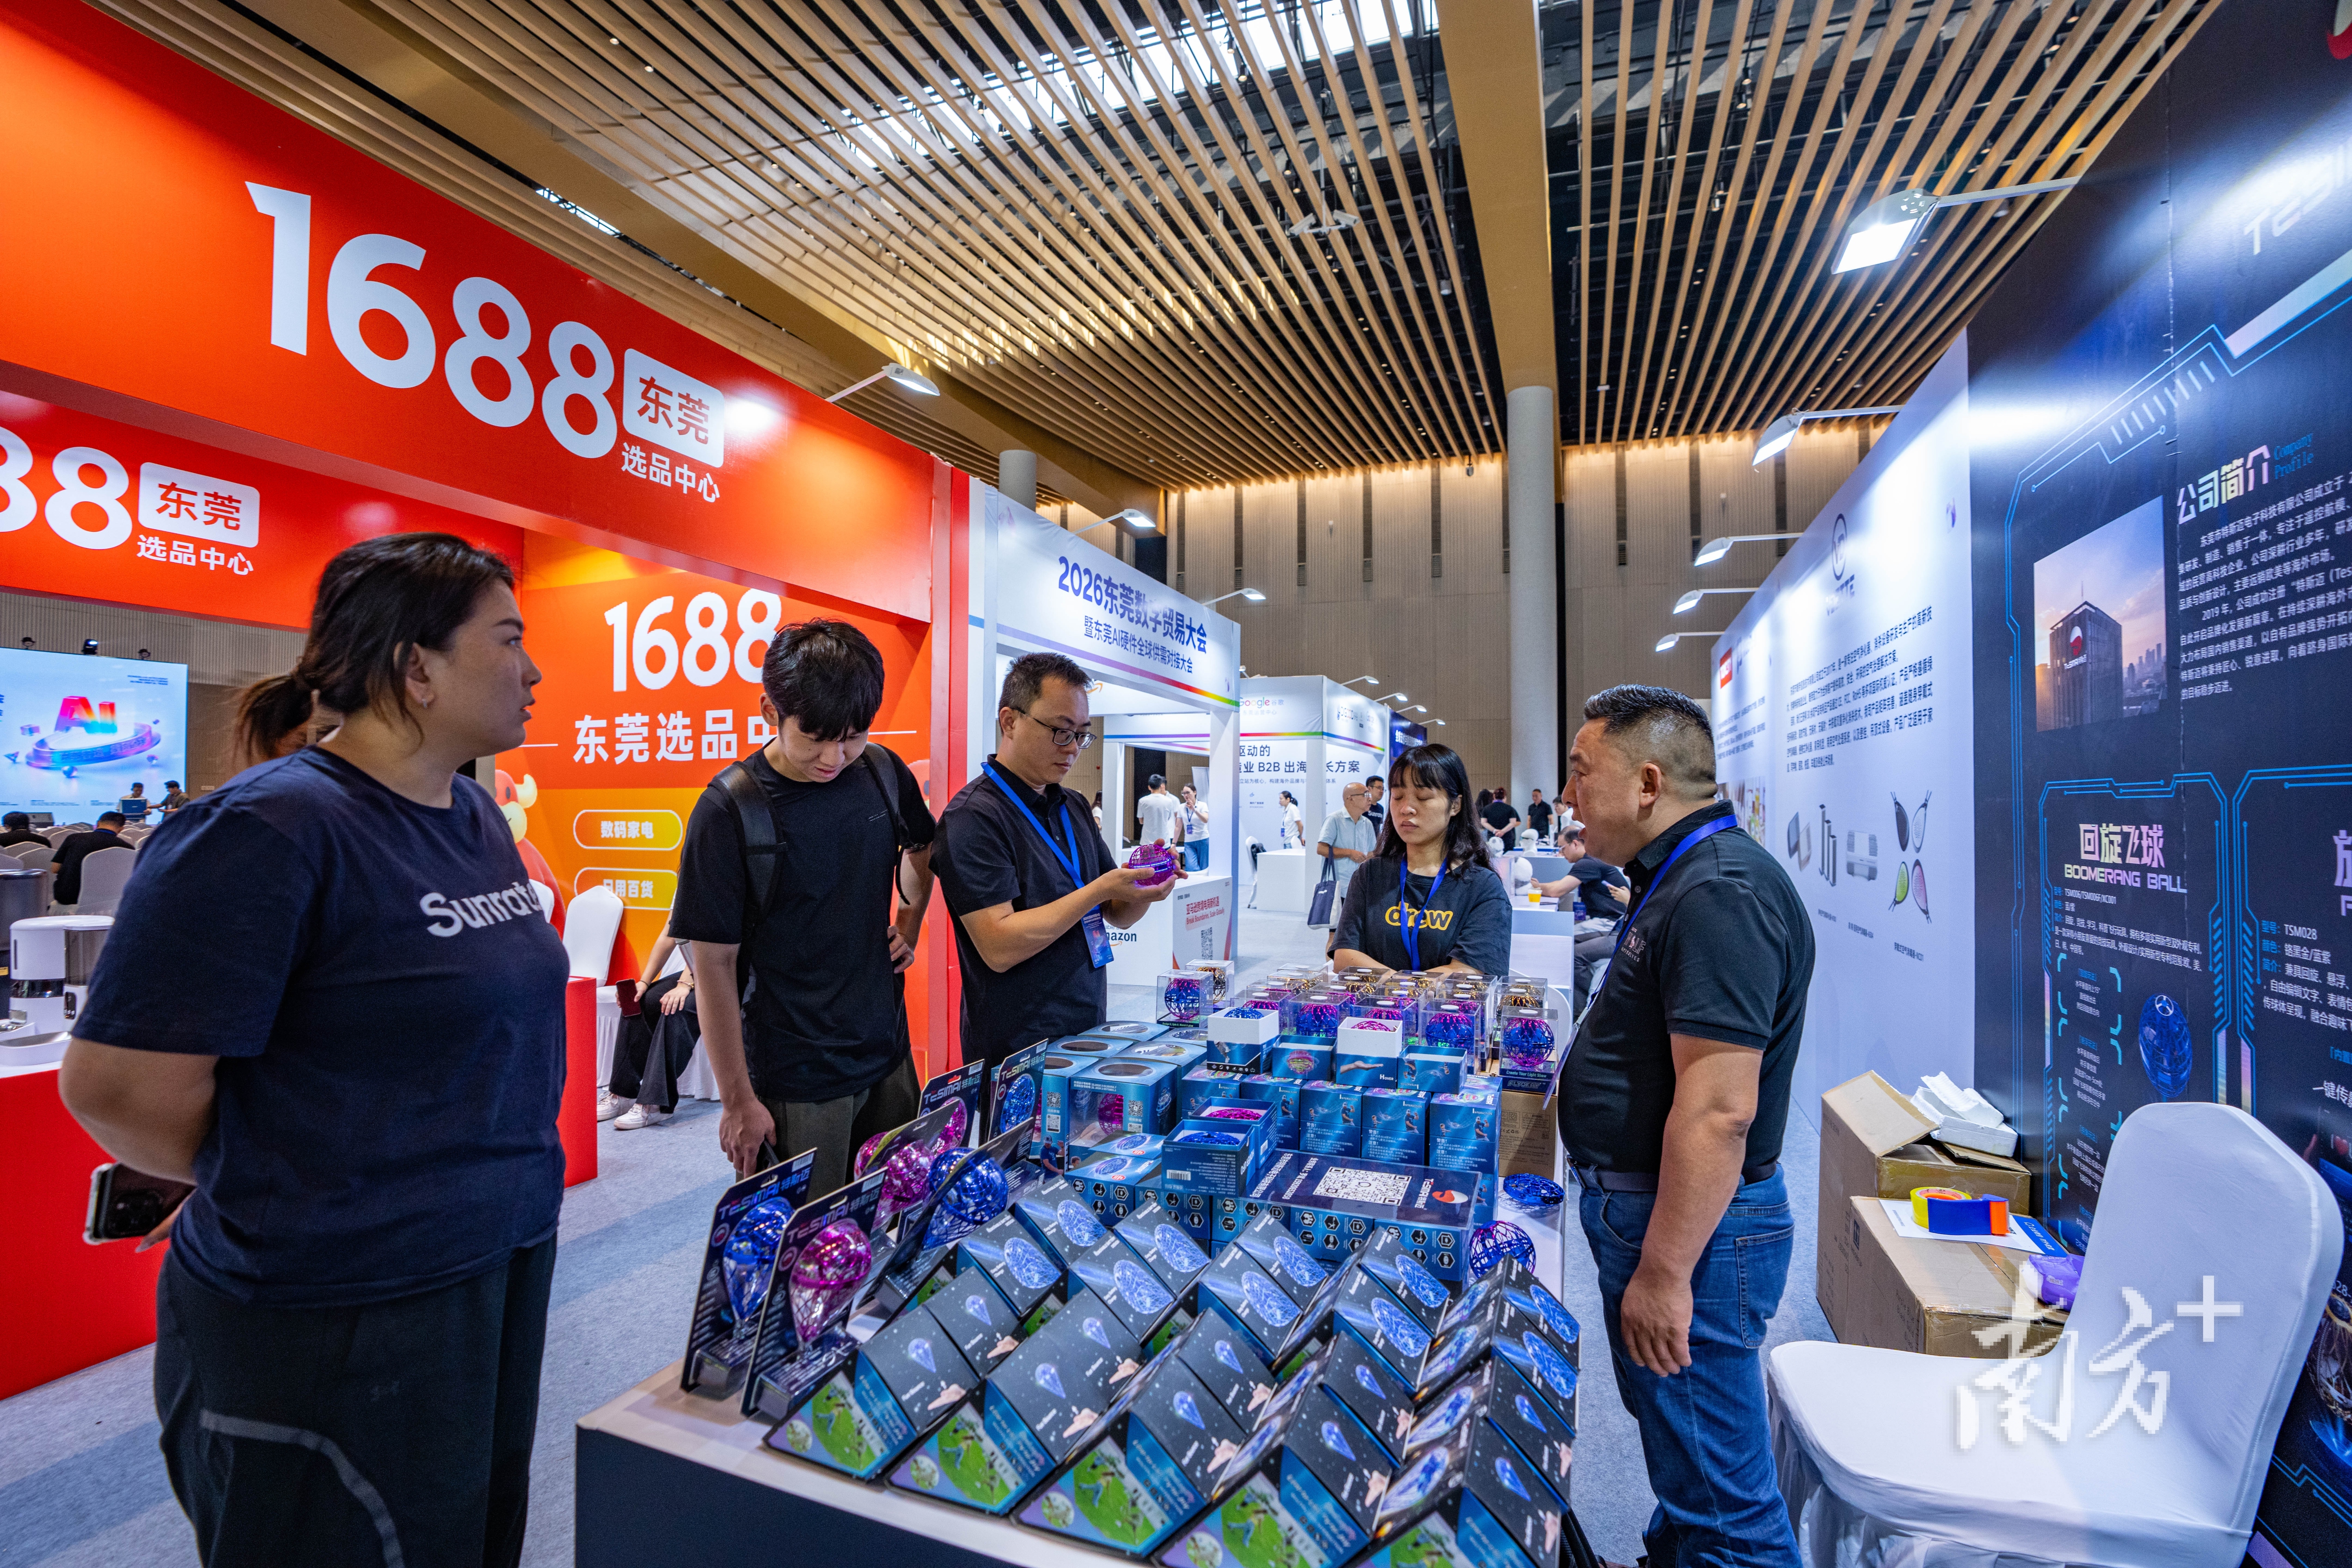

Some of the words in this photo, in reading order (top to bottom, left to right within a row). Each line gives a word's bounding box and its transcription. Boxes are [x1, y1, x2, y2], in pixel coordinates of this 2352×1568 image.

[245, 181, 617, 458] 1688
[637, 376, 710, 445] 东莞
[2274, 433, 2313, 460] Company
[2274, 452, 2313, 479] Profile
[621, 442, 720, 503] 选品中心
[2177, 445, 2270, 524] 公司简介
[156, 481, 241, 531] 东莞
[2200, 475, 2344, 548] 东莞市特斯迈电子科技有限公司成立于
[137, 534, 254, 576] 选品中心
[1058, 556, 1207, 654] 2026东莞数字贸易大会
[2202, 606, 2220, 620] 2019
[604, 588, 782, 692] 1688
[1084, 615, 1193, 674] 暨东莞AI硬件全球供需对接大会
[54, 696, 118, 734] AI
[1240, 697, 1270, 708] Google
[573, 710, 778, 764] 东莞选品中
[1258, 762, 1280, 772] B2B
[1285, 761, 1307, 773] 出海
[1326, 761, 1360, 773] 长方案
[601, 821, 654, 839] 数码家电
[2080, 824, 2165, 868] 回旋飞球
[604, 879, 653, 899] 日用百货
[2064, 864, 2141, 887] BOOMERANG
[2147, 873, 2188, 894] BALL
[2284, 924, 2318, 940] TSM028
[1508, 1080, 1541, 1089] FLYOKAY
[1414, 1196, 1427, 1208] 特斯迈
